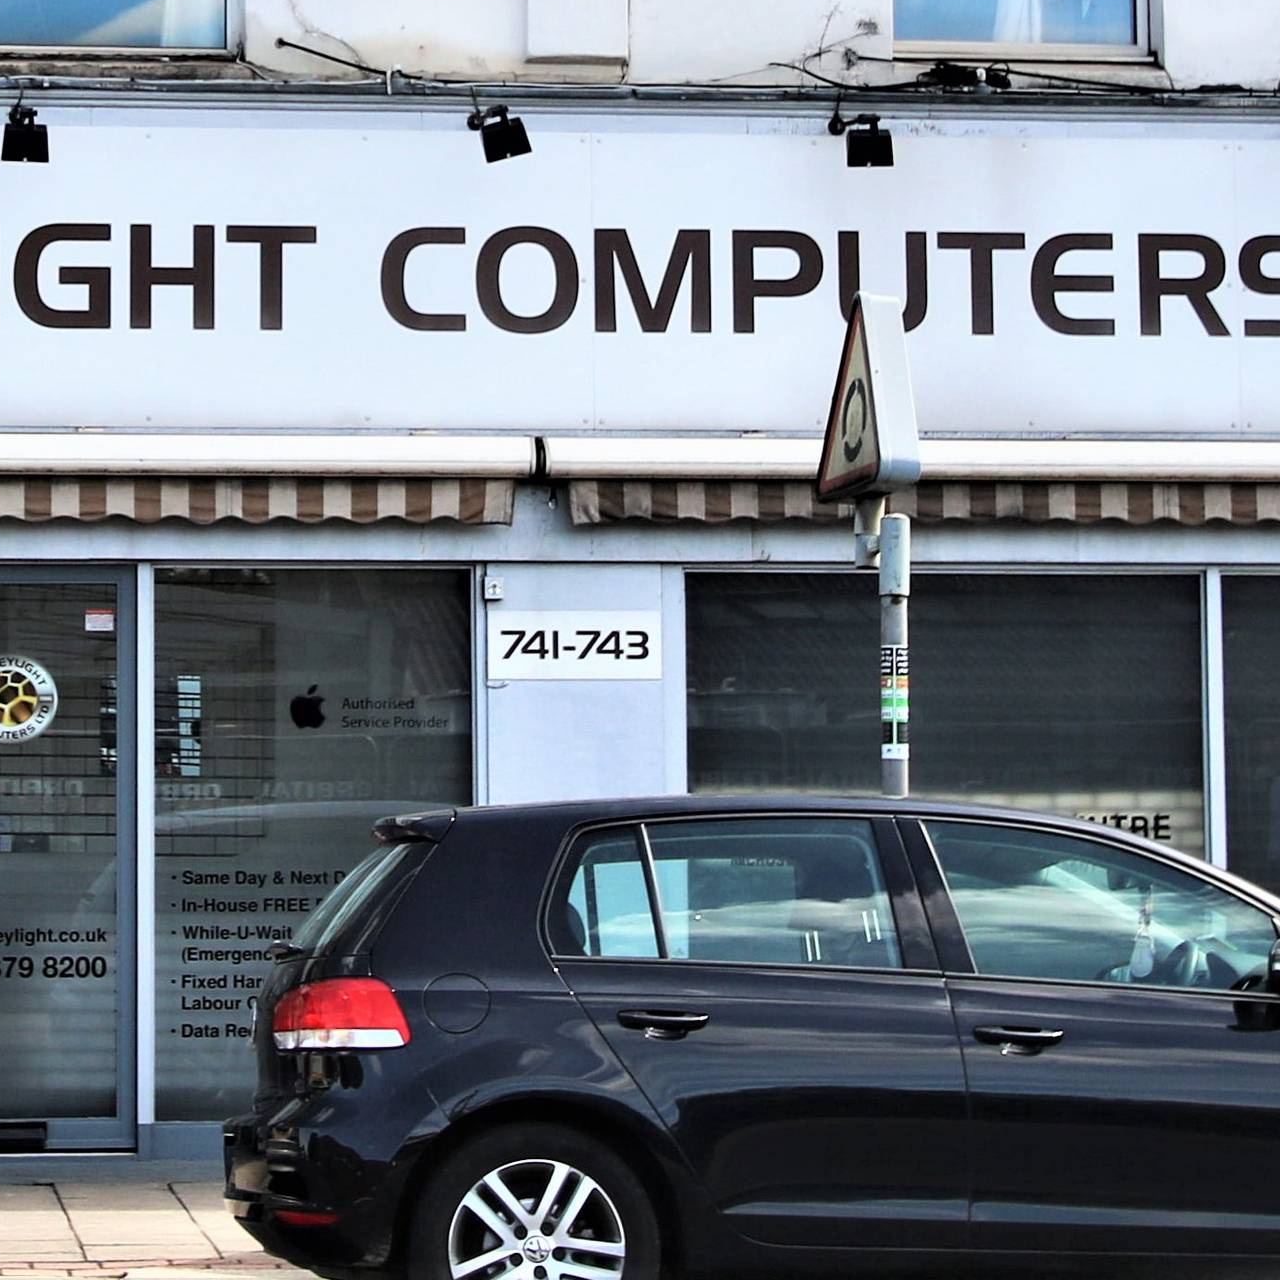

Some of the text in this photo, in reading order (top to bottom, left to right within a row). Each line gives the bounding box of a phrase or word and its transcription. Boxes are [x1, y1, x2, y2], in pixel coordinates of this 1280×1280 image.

[501, 630, 649, 660] 741-743
[342, 698, 414, 710] Authorised
[35, 705, 49, 724] LTD
[342, 716, 448, 728] Service Provider
[182, 870, 230, 885] Same
[235, 871, 266, 888] Day
[273, 871, 284, 885] &
[290, 871, 328, 884] Next
[182, 898, 258, 912] In-House
[263, 898, 310, 912] FREE
[183, 926, 292, 940] While-U-Wait
[42, 956, 107, 978] 8200
[182, 975, 232, 989] Fixed
[182, 996, 241, 1010] Labour
[181, 1024, 219, 1038] Data
